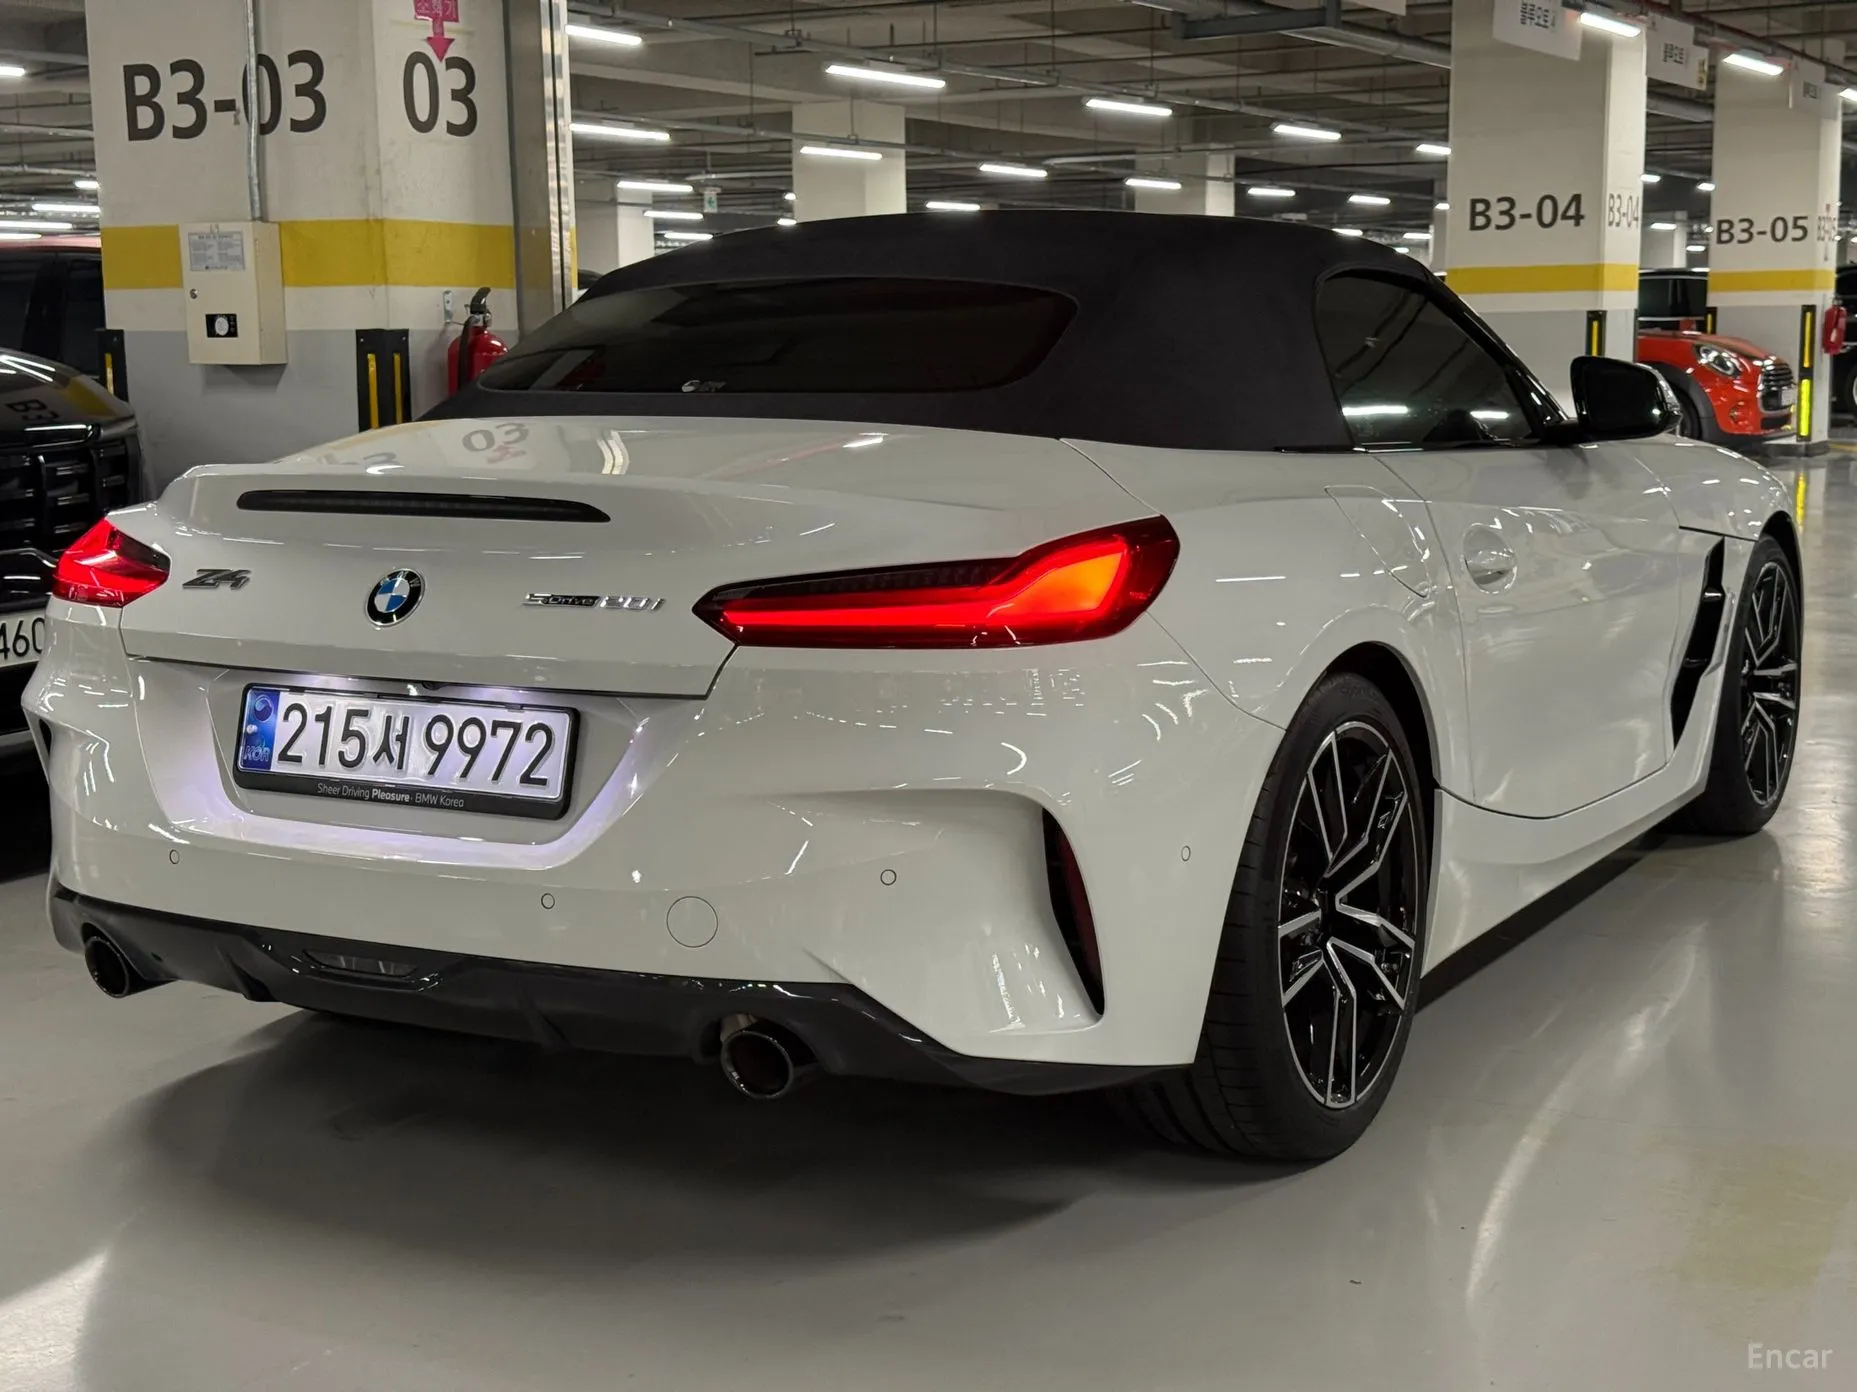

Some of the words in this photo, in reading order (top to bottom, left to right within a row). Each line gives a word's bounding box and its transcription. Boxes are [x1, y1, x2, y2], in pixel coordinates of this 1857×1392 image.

[122, 50, 327, 141] B3-03
[403, 51, 478, 137] 03
[1469, 193, 1585, 231] B3-04
[1608, 192, 1639, 228] B3-04
[1716, 216, 1809, 244] B3-05
[182, 568, 252, 590] Z4
[277, 702, 410, 771] 215서
[425, 714, 554, 787] 9972
[317, 782, 340, 795] Sheer
[341, 785, 370, 799] Driving
[371, 788, 410, 802] Pleasure
[415, 793, 438, 805] BMW
[440, 796, 465, 808] Korea
